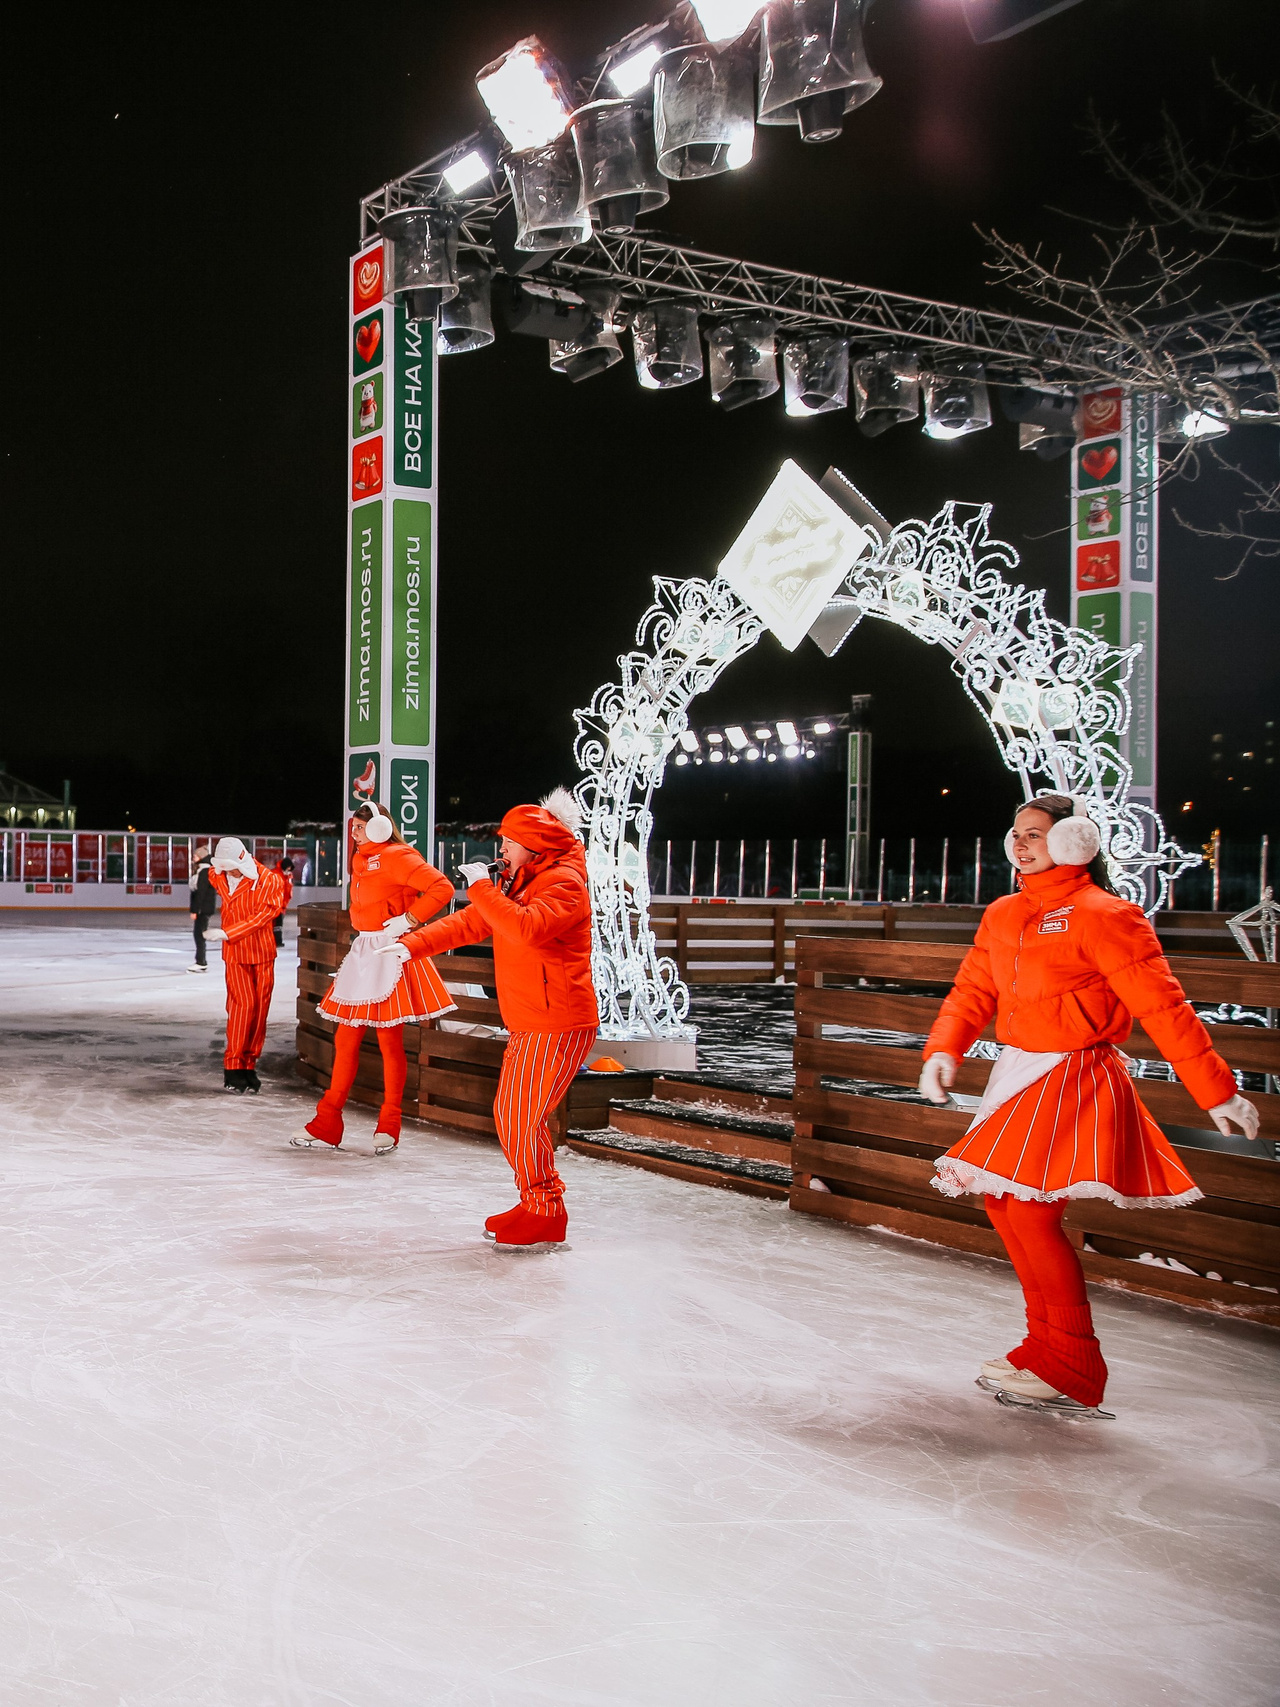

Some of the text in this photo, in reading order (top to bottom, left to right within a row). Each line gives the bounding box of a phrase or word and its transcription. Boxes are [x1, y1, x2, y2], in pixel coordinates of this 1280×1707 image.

[404, 306, 422, 472] ВСЕ НА КА
[1135, 483, 1148, 516] НА
[1135, 522, 1148, 569] ВСЕ
[357, 527, 372, 722] zima.mos.ru
[402, 536, 420, 710] zima.mos.ru
